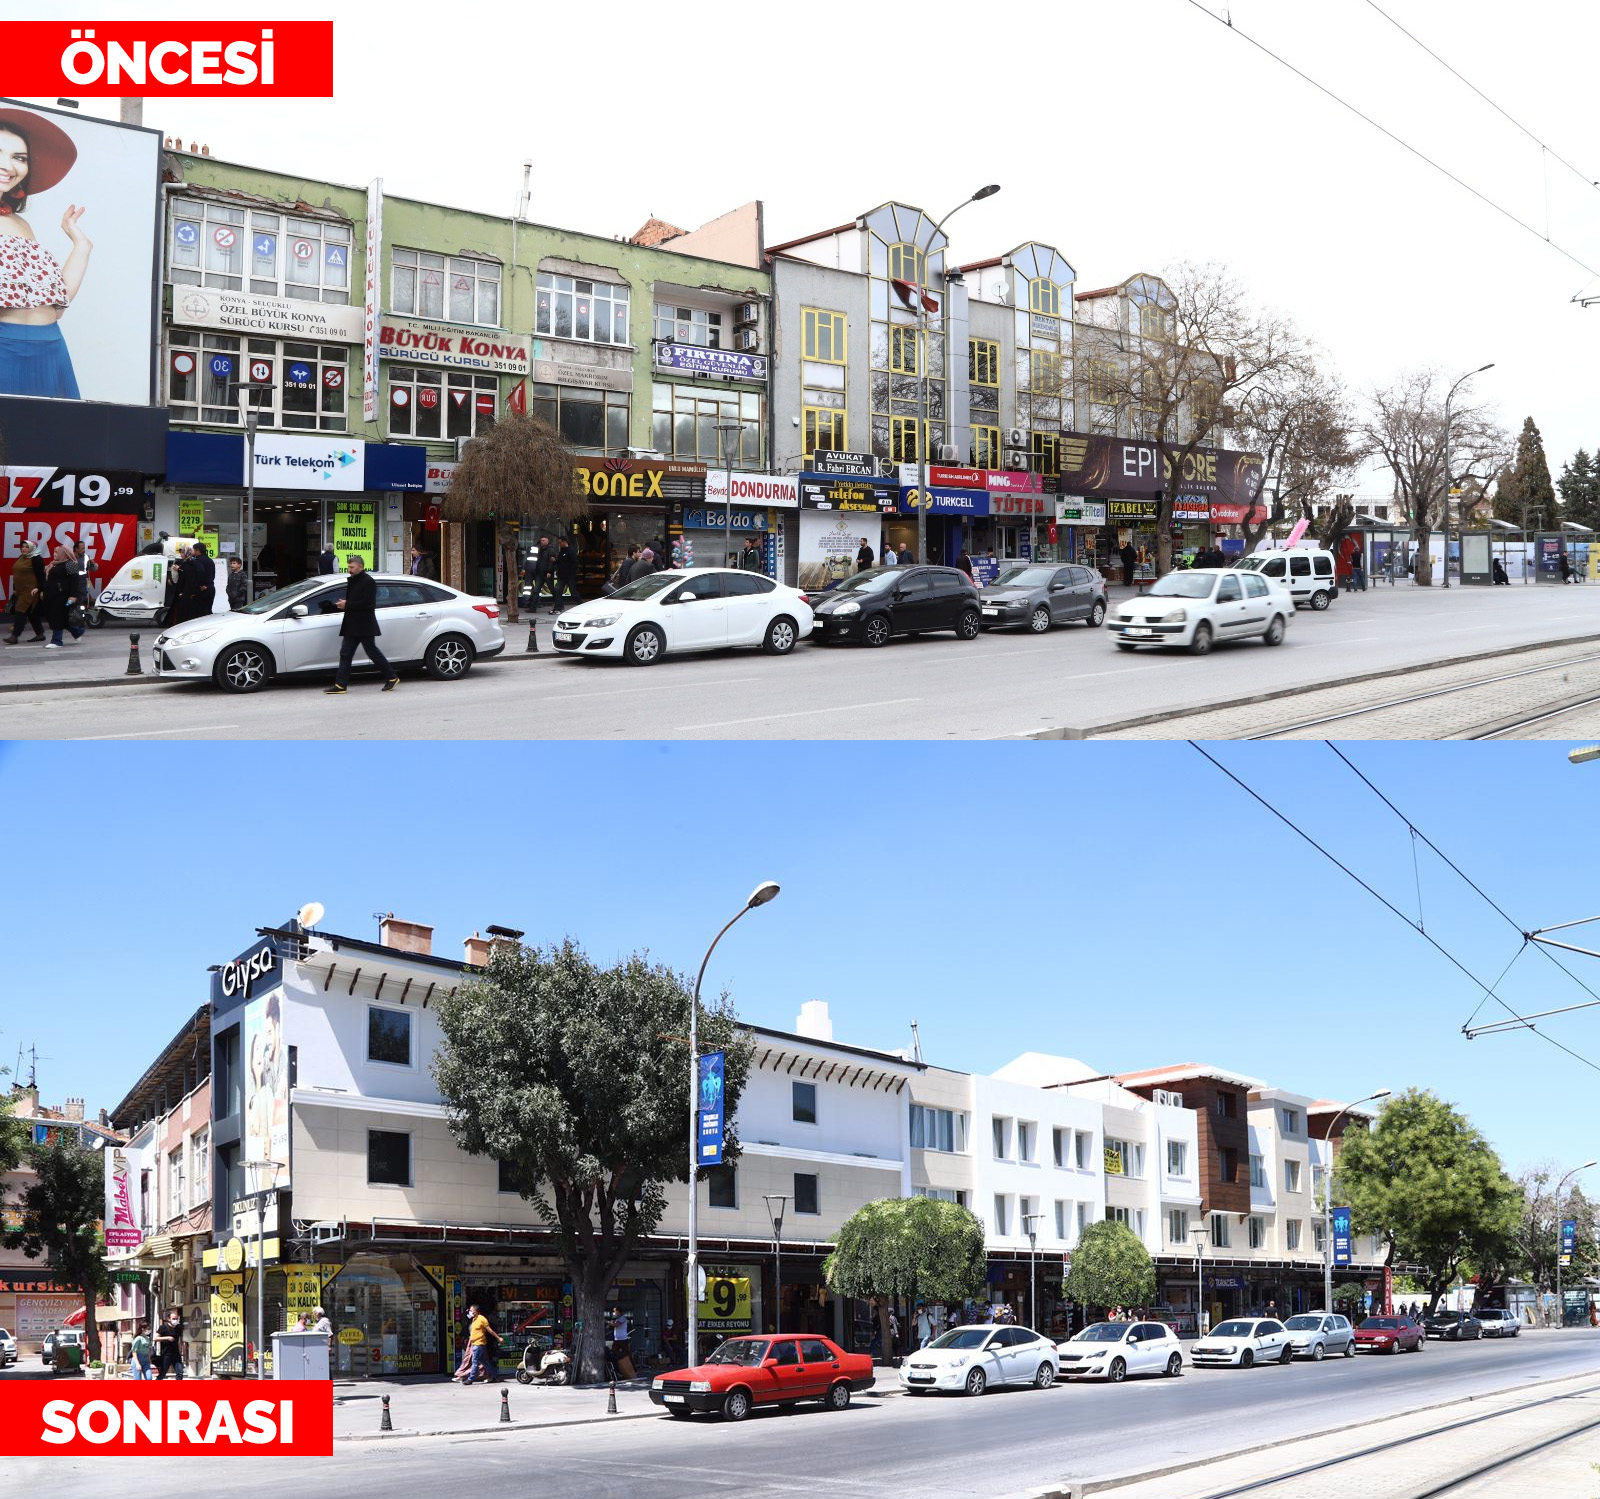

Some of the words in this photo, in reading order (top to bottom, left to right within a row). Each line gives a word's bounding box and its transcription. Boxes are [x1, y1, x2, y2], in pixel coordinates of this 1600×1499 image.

[220, 295, 246, 305] KONYA
[220, 304, 249, 316] ÖZEL
[251, 307, 288, 320] BÜYÜK
[291, 313, 326, 324] KONYA
[220, 316, 265, 329] SÜRÜCÜ
[268, 321, 305, 333] KURSU
[316, 326, 328, 335] 351
[329, 328, 338, 336] 09
[339, 329, 347, 337] 01
[365, 302, 374, 383] KONYA
[380, 326, 453, 353] BÜYÜK
[459, 336, 527, 362] KONYA
[380, 347, 440, 362] SÜRÜCÜ
[444, 355, 490, 368] KURSU
[494, 361, 507, 370] 351
[508, 363, 517, 371] 09
[518, 364, 526, 373] 01
[674, 347, 752, 366] FIRTINA
[711, 366, 748, 376] KURUMU
[254, 454, 282, 466] Türk
[286, 455, 335, 469] Telekom
[826, 452, 864, 462] AVUKAT
[1122, 446, 1158, 478] EPI
[826, 464, 845, 473] Fahri
[846, 465, 872, 475] ERCAN
[988, 475, 1011, 487] MNG
[731, 480, 797, 501] DONDURMA
[935, 496, 974, 508] TURKCELL
[994, 493, 1044, 513] TÜTEN
[1217, 510, 1239, 518] vodafone
[341, 526, 367, 538] TAKSİTLE
[354, 541, 372, 551] ALANA
[99, 591, 144, 604] Glutton
[114, 1171, 136, 1228] Mabel
[213, 1303, 219, 1312] 3
[220, 1301, 238, 1313] GÜN
[212, 1316, 240, 1327] KALICI
